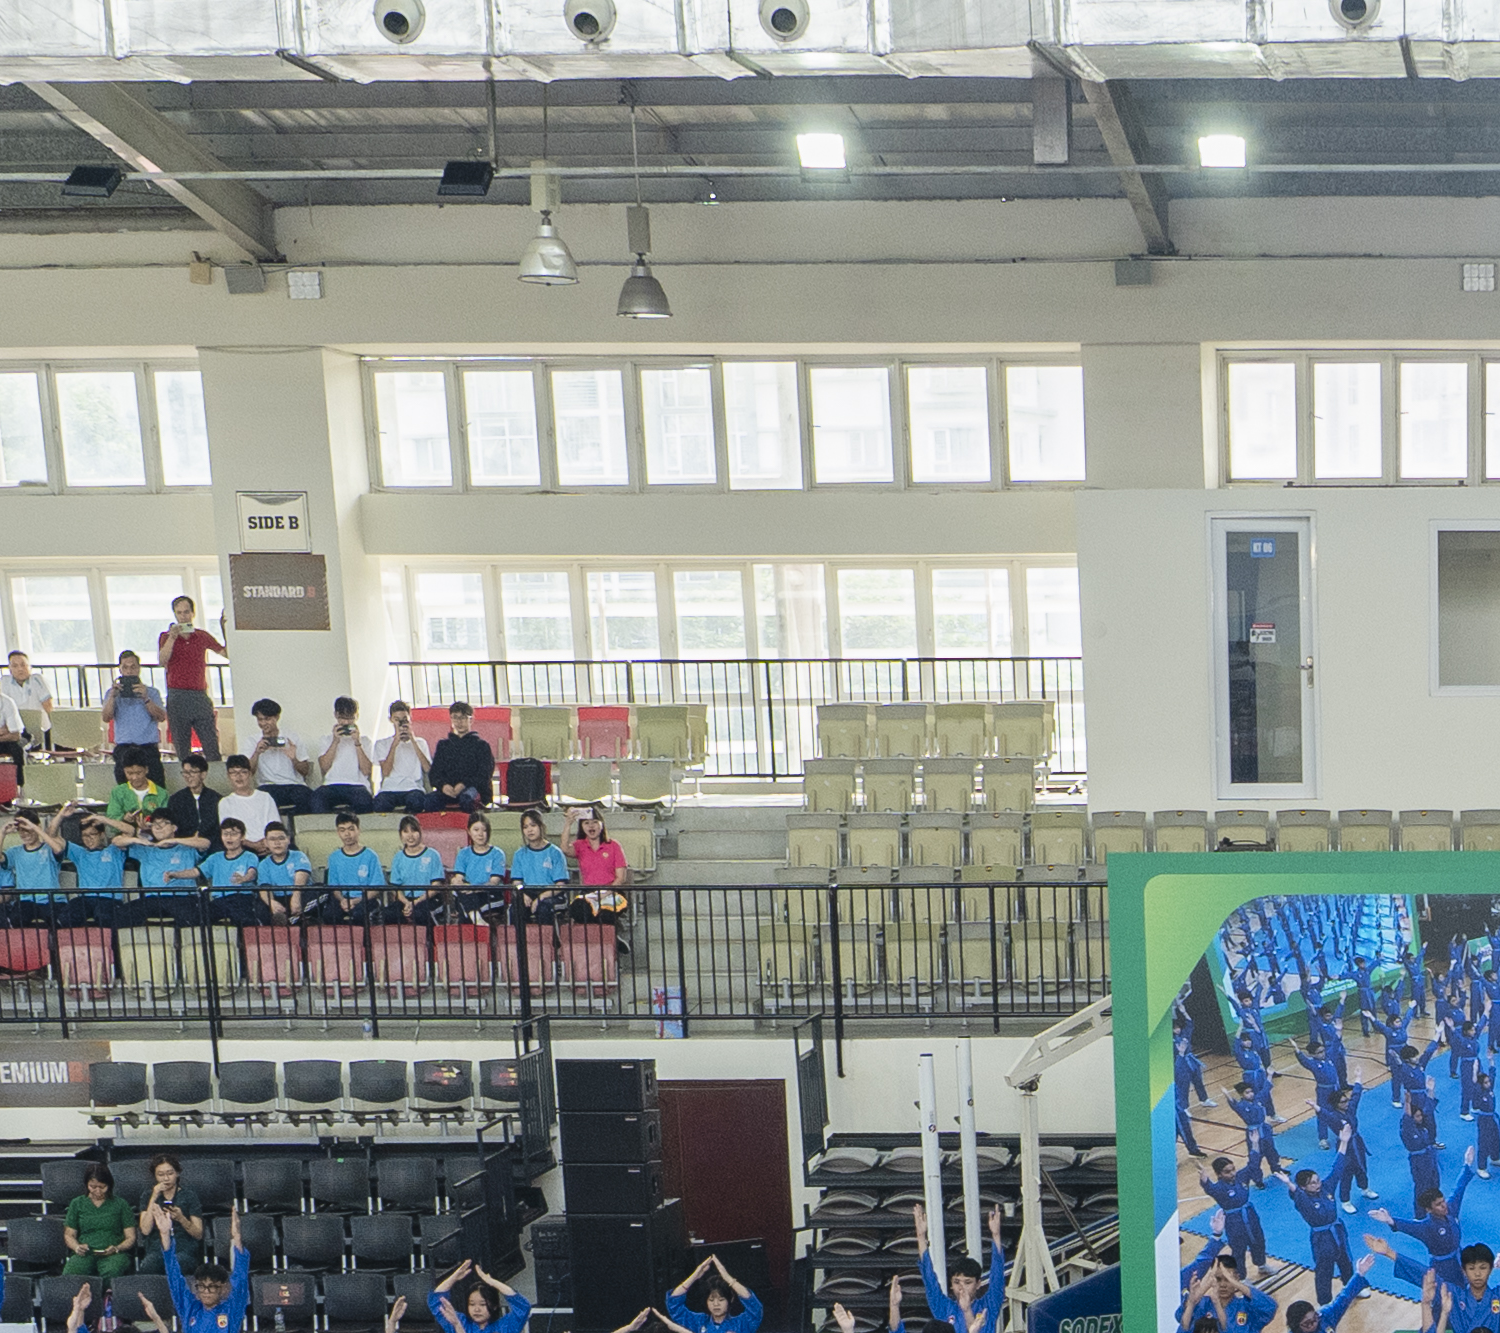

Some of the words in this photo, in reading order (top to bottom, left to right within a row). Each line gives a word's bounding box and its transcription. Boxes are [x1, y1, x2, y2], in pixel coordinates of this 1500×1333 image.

[247, 516, 285, 530] SIDE
[288, 516, 299, 530] B
[243, 585, 305, 598] STANDARD
